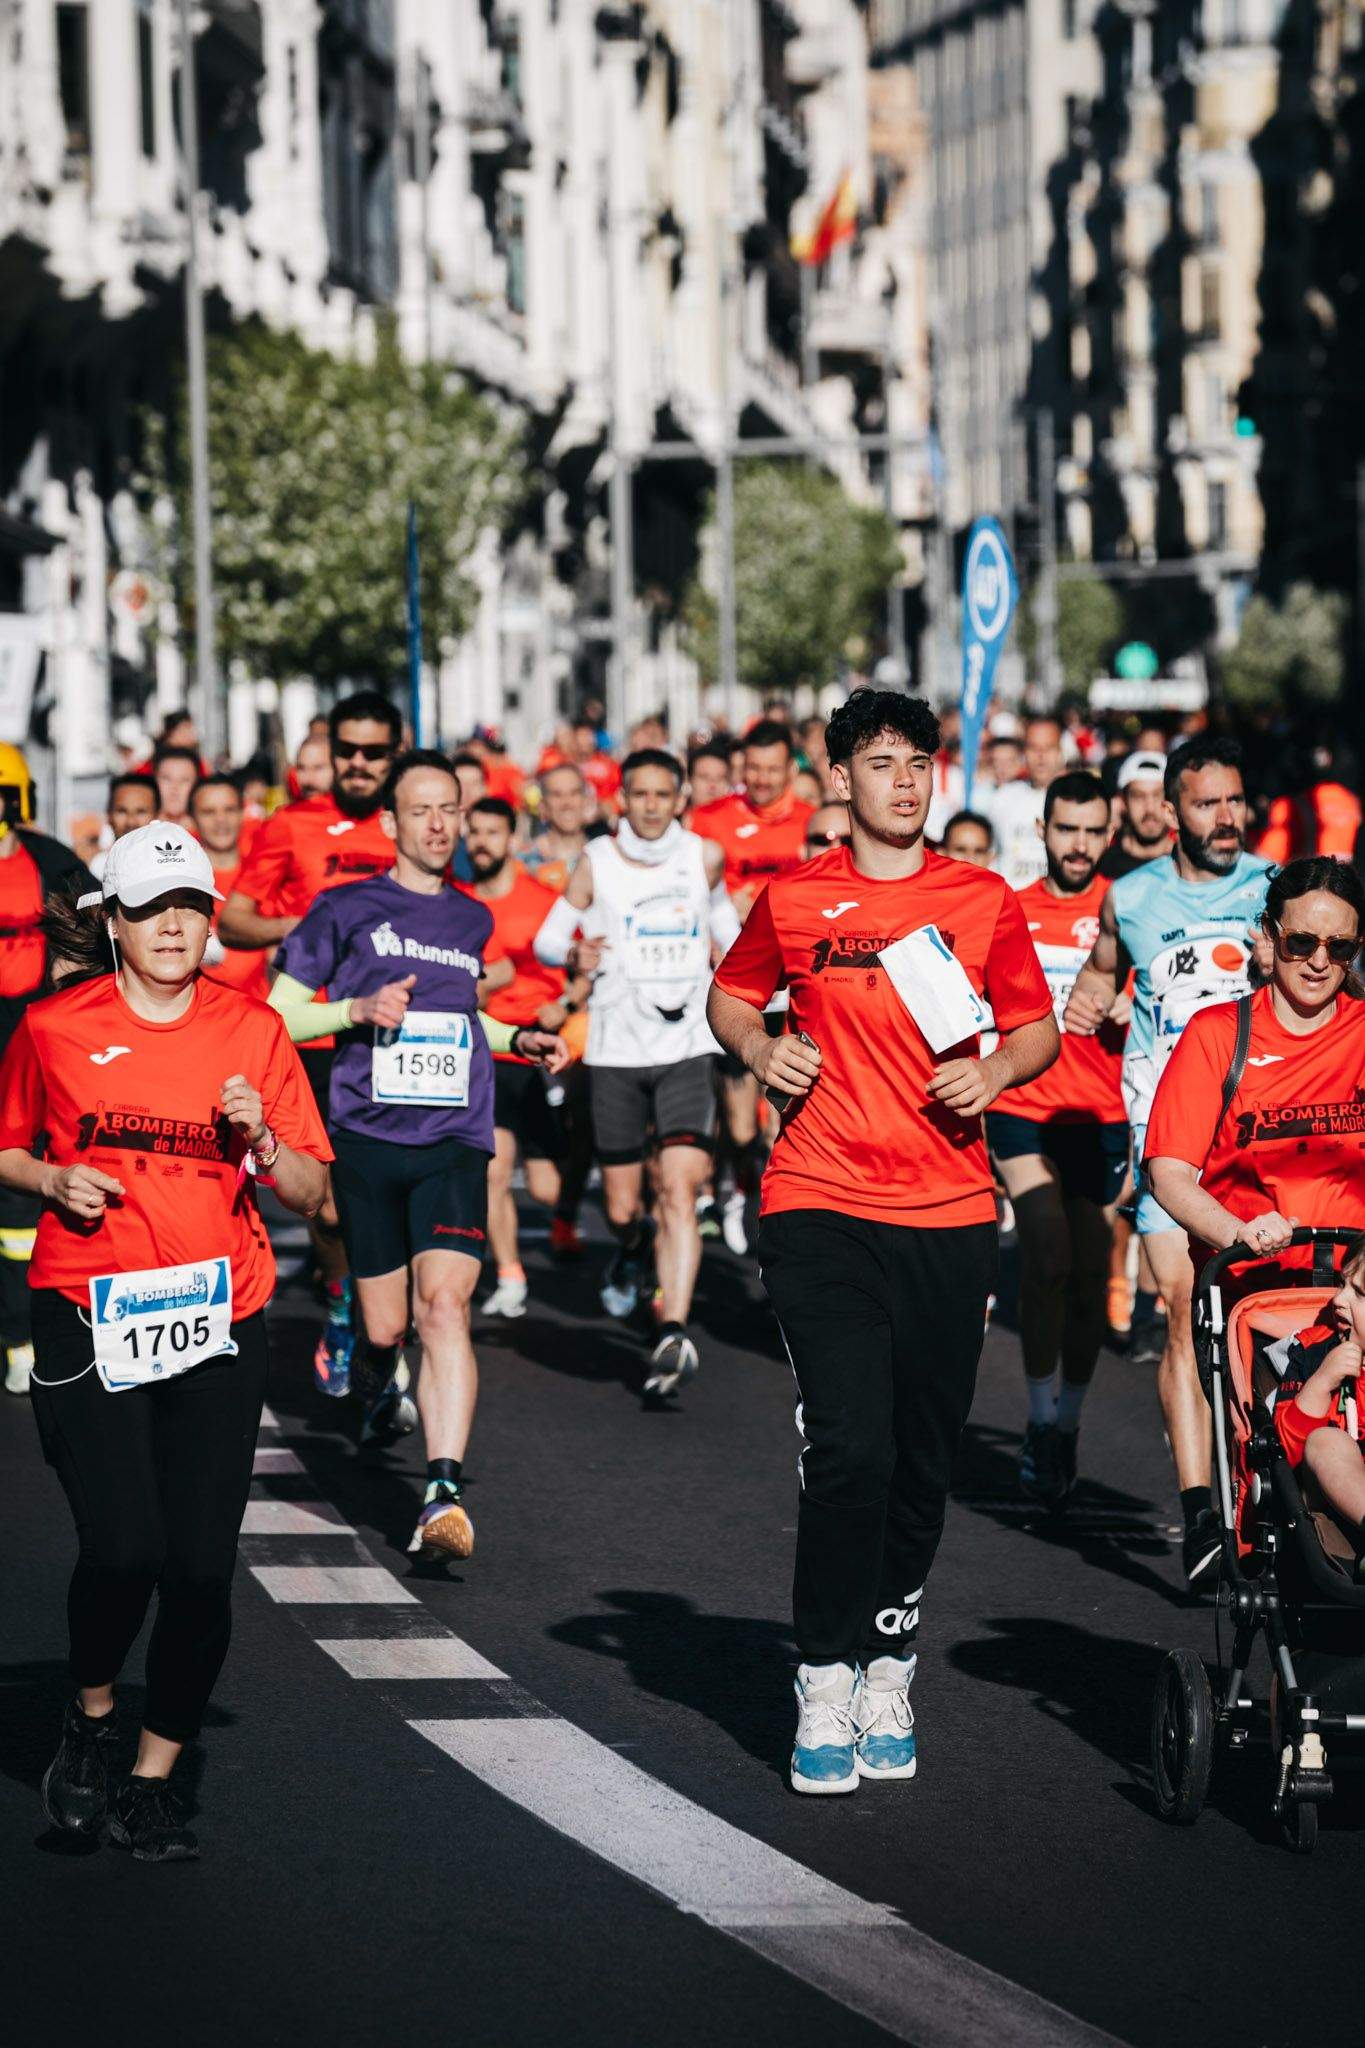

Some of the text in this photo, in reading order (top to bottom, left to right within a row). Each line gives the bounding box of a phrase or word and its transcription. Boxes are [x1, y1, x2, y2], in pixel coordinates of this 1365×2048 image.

[404, 938, 480, 978] Running
[394, 1053, 456, 1076] 1598
[111, 1114, 217, 1141] BOMBERO
[1312, 1119, 1327, 1133] de
[154, 1135, 169, 1153] de
[135, 1283, 207, 1303] BOMBEROS
[123, 1315, 210, 1359] 1705
